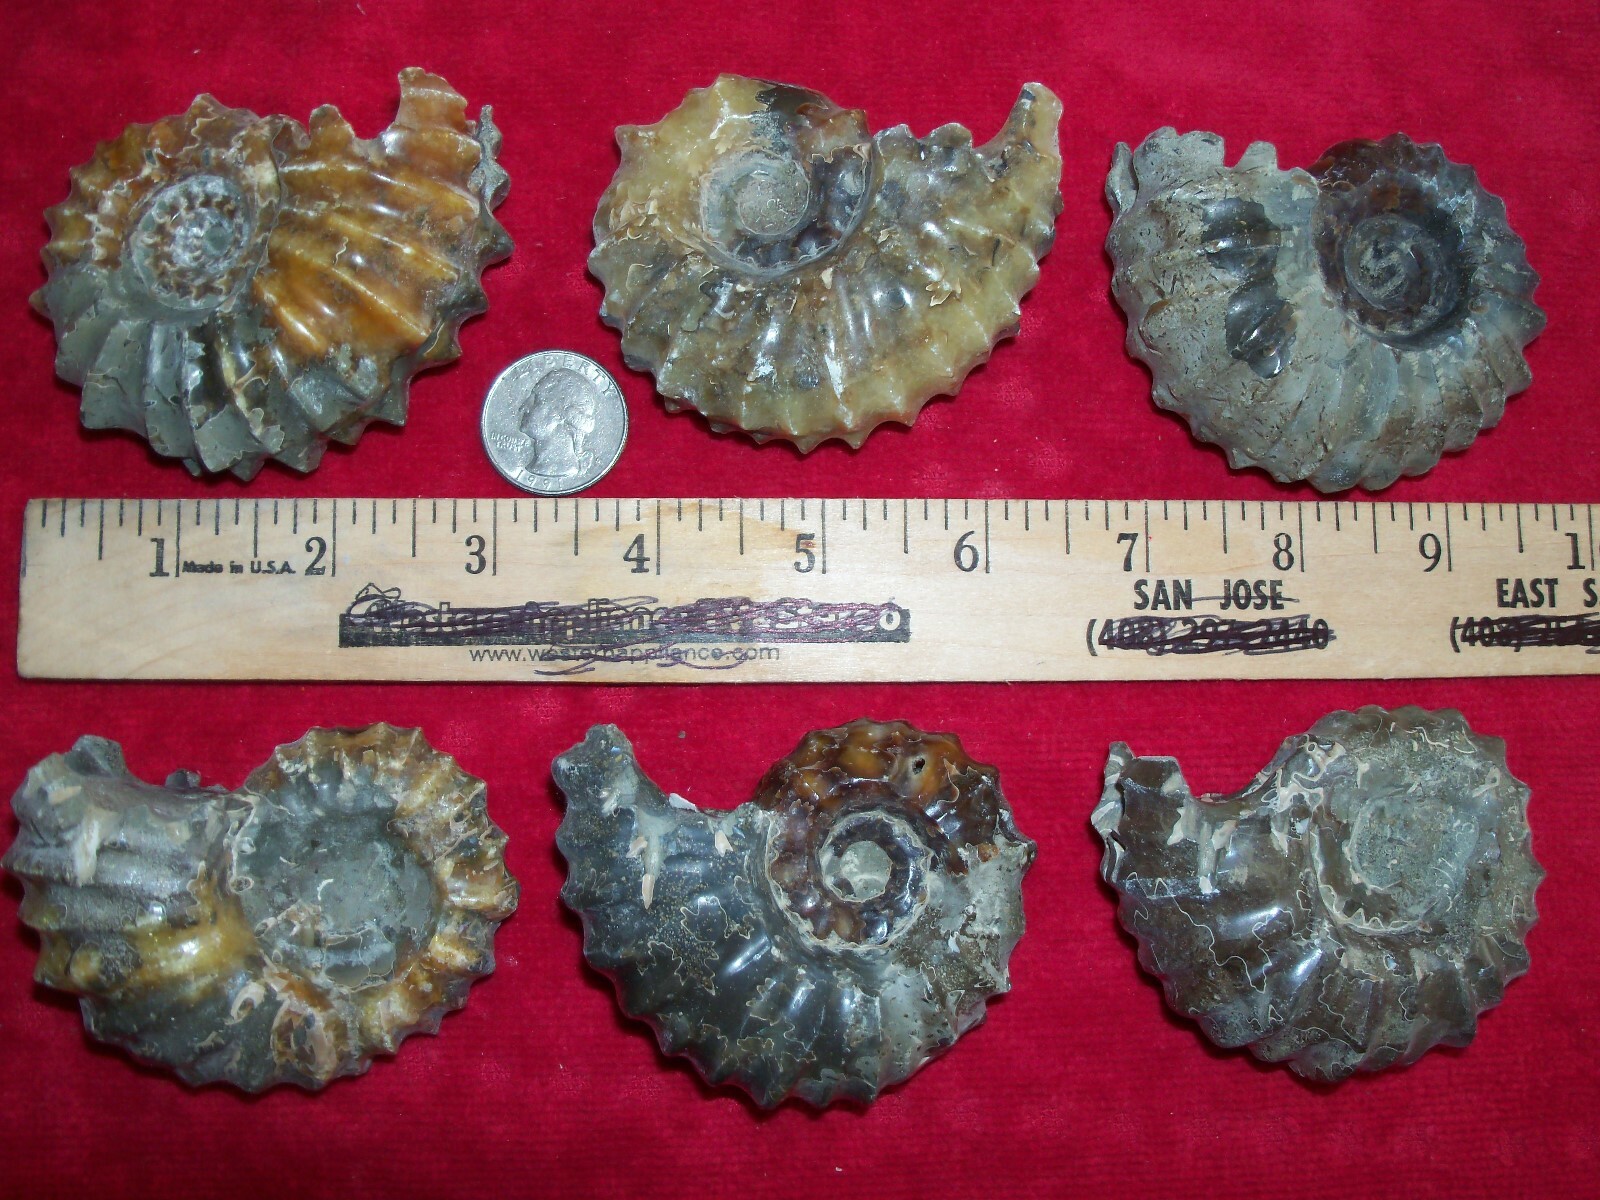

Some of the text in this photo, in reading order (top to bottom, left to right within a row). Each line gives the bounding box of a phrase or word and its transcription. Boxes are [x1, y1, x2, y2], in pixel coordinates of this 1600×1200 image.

[150, 538, 169, 577] 1
[182, 560, 224, 574] Made
[229, 560, 244, 574] in
[304, 536, 327, 576] 2
[465, 534, 487, 575] 3
[622, 533, 651, 574] 4
[794, 533, 815, 573] 5
[953, 530, 979, 573] 6
[1116, 532, 1139, 572] 7
[1272, 532, 1295, 572] 8
[1418, 532, 1442, 573] 9
[1133, 578, 1285, 611] SAN JOSE
[1495, 577, 1600, 609] EAST S
